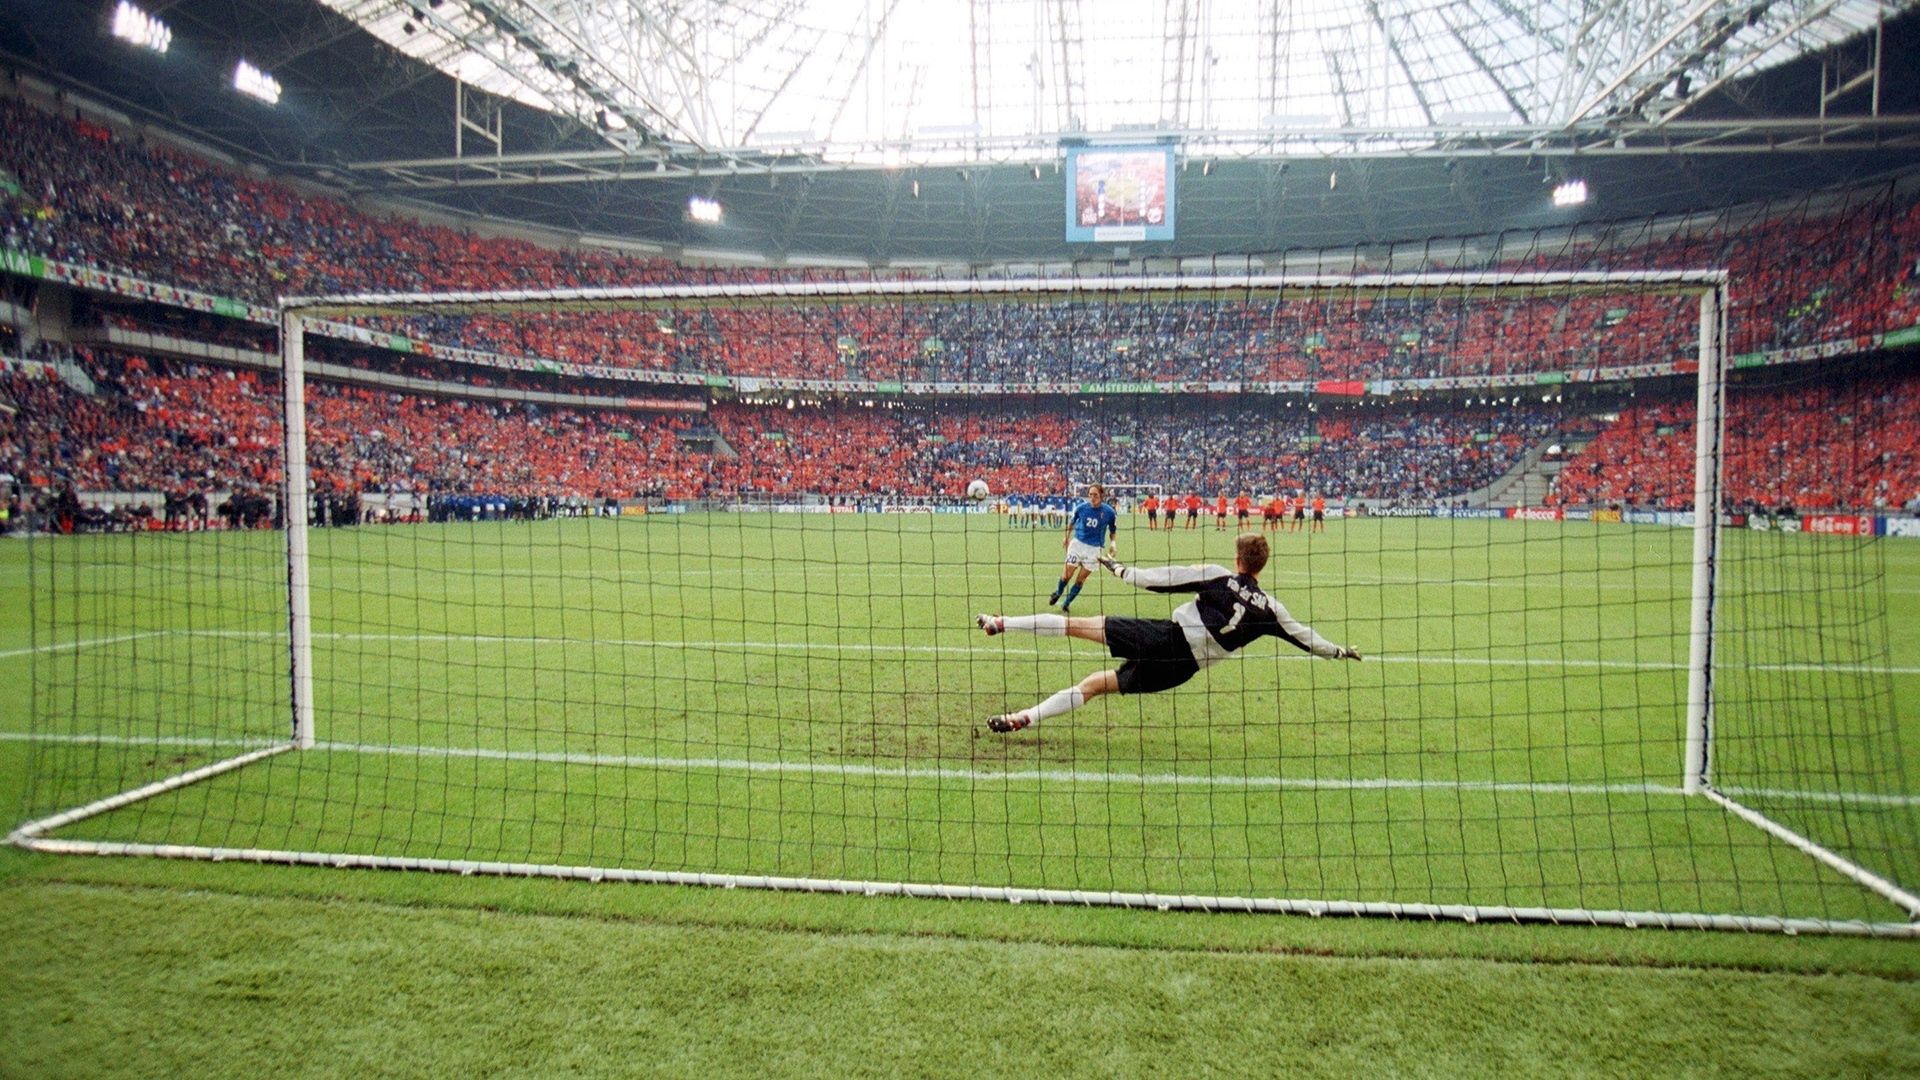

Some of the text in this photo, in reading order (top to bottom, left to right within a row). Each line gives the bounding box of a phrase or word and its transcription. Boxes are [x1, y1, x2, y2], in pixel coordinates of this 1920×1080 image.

[1088, 383, 1152, 393] AMSTERDAM
[946, 506, 965, 514] FLY
[1368, 506, 1430, 517] PlayStation
[1514, 508, 1556, 519] Adecco
[1086, 517, 1098, 528] 20
[1066, 554, 1077, 564] 20
[1220, 602, 1246, 634] 1
